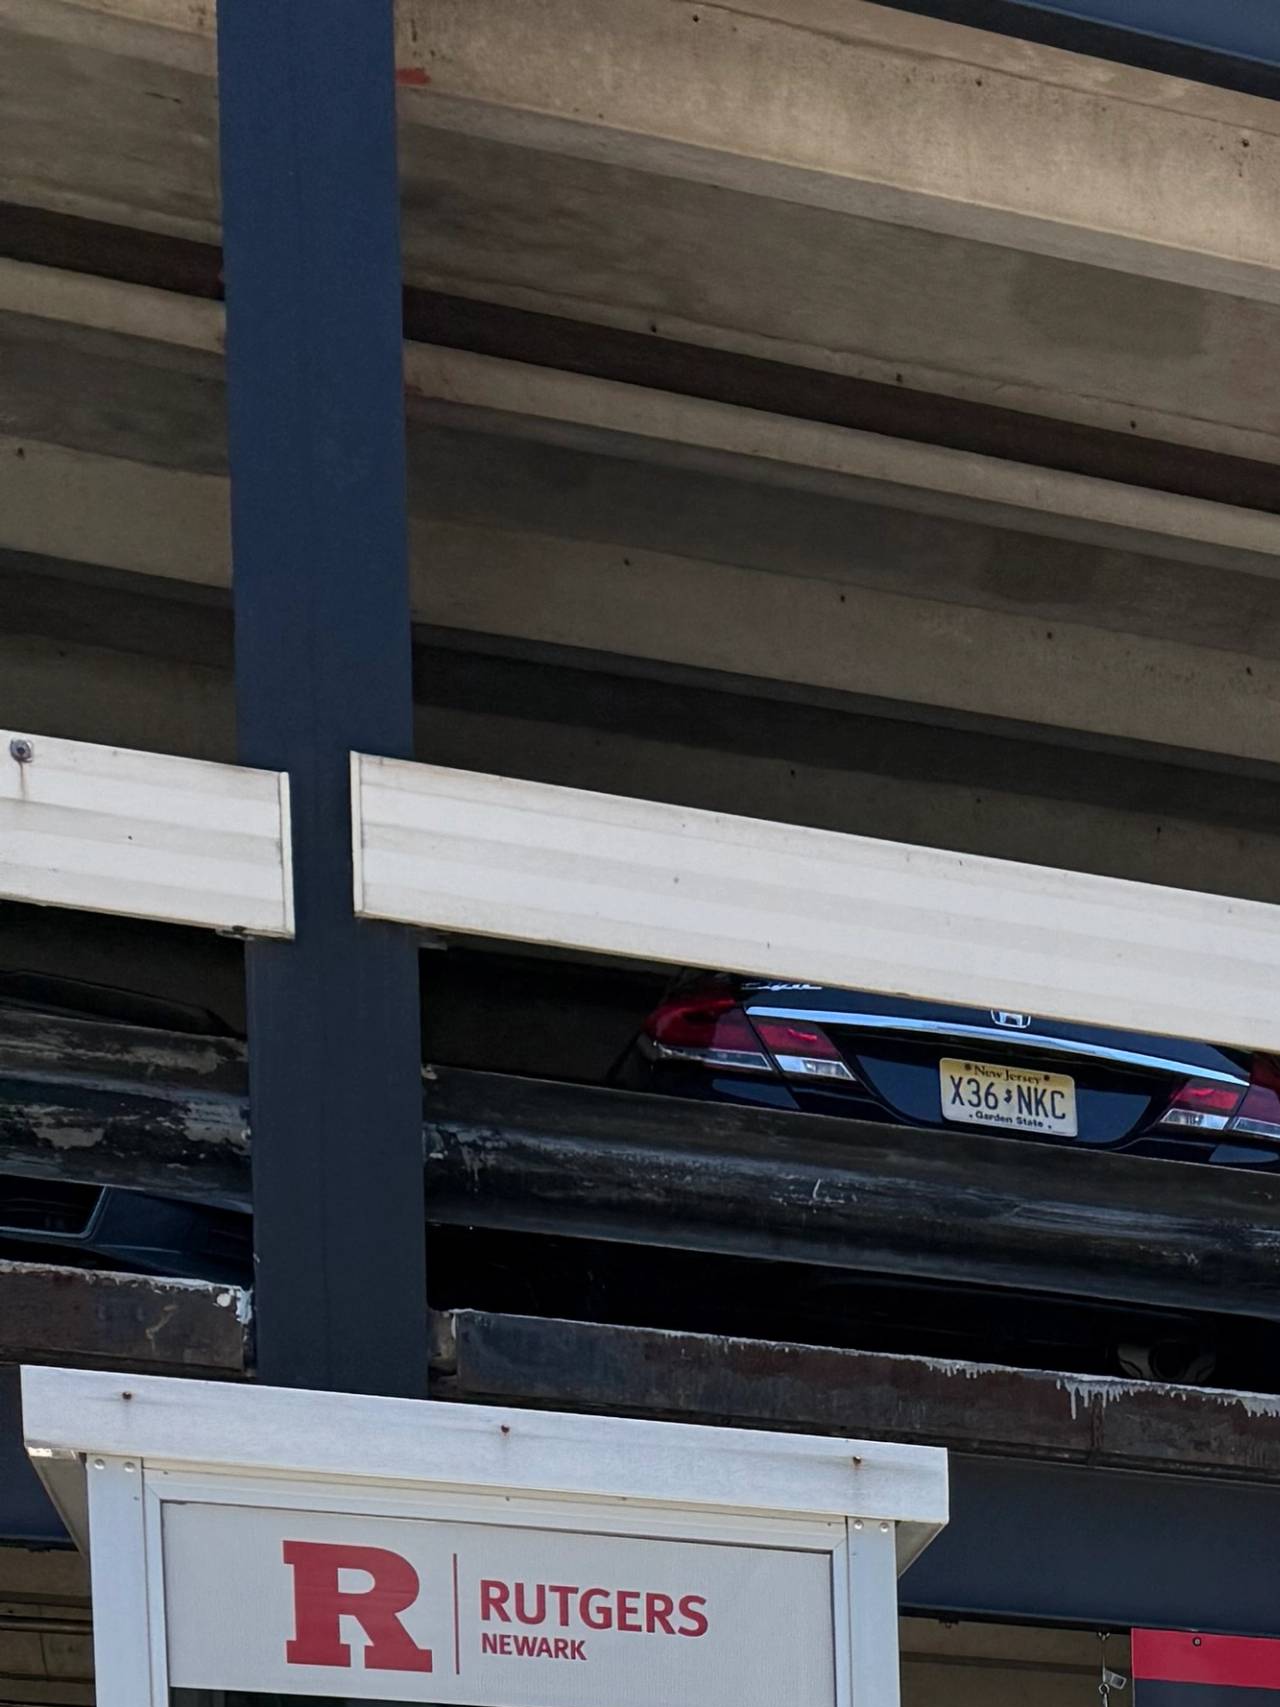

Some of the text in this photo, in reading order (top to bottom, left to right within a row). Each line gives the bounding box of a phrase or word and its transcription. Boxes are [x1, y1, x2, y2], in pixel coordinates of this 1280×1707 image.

[974, 1065, 1041, 1084] New Jersey
[950, 1075, 1066, 1119] X36 NKC
[976, 1111, 1043, 1128] Garden State
[282, 1539, 709, 1673] R RUTGERS
[481, 1632, 587, 1661] NEWARK
